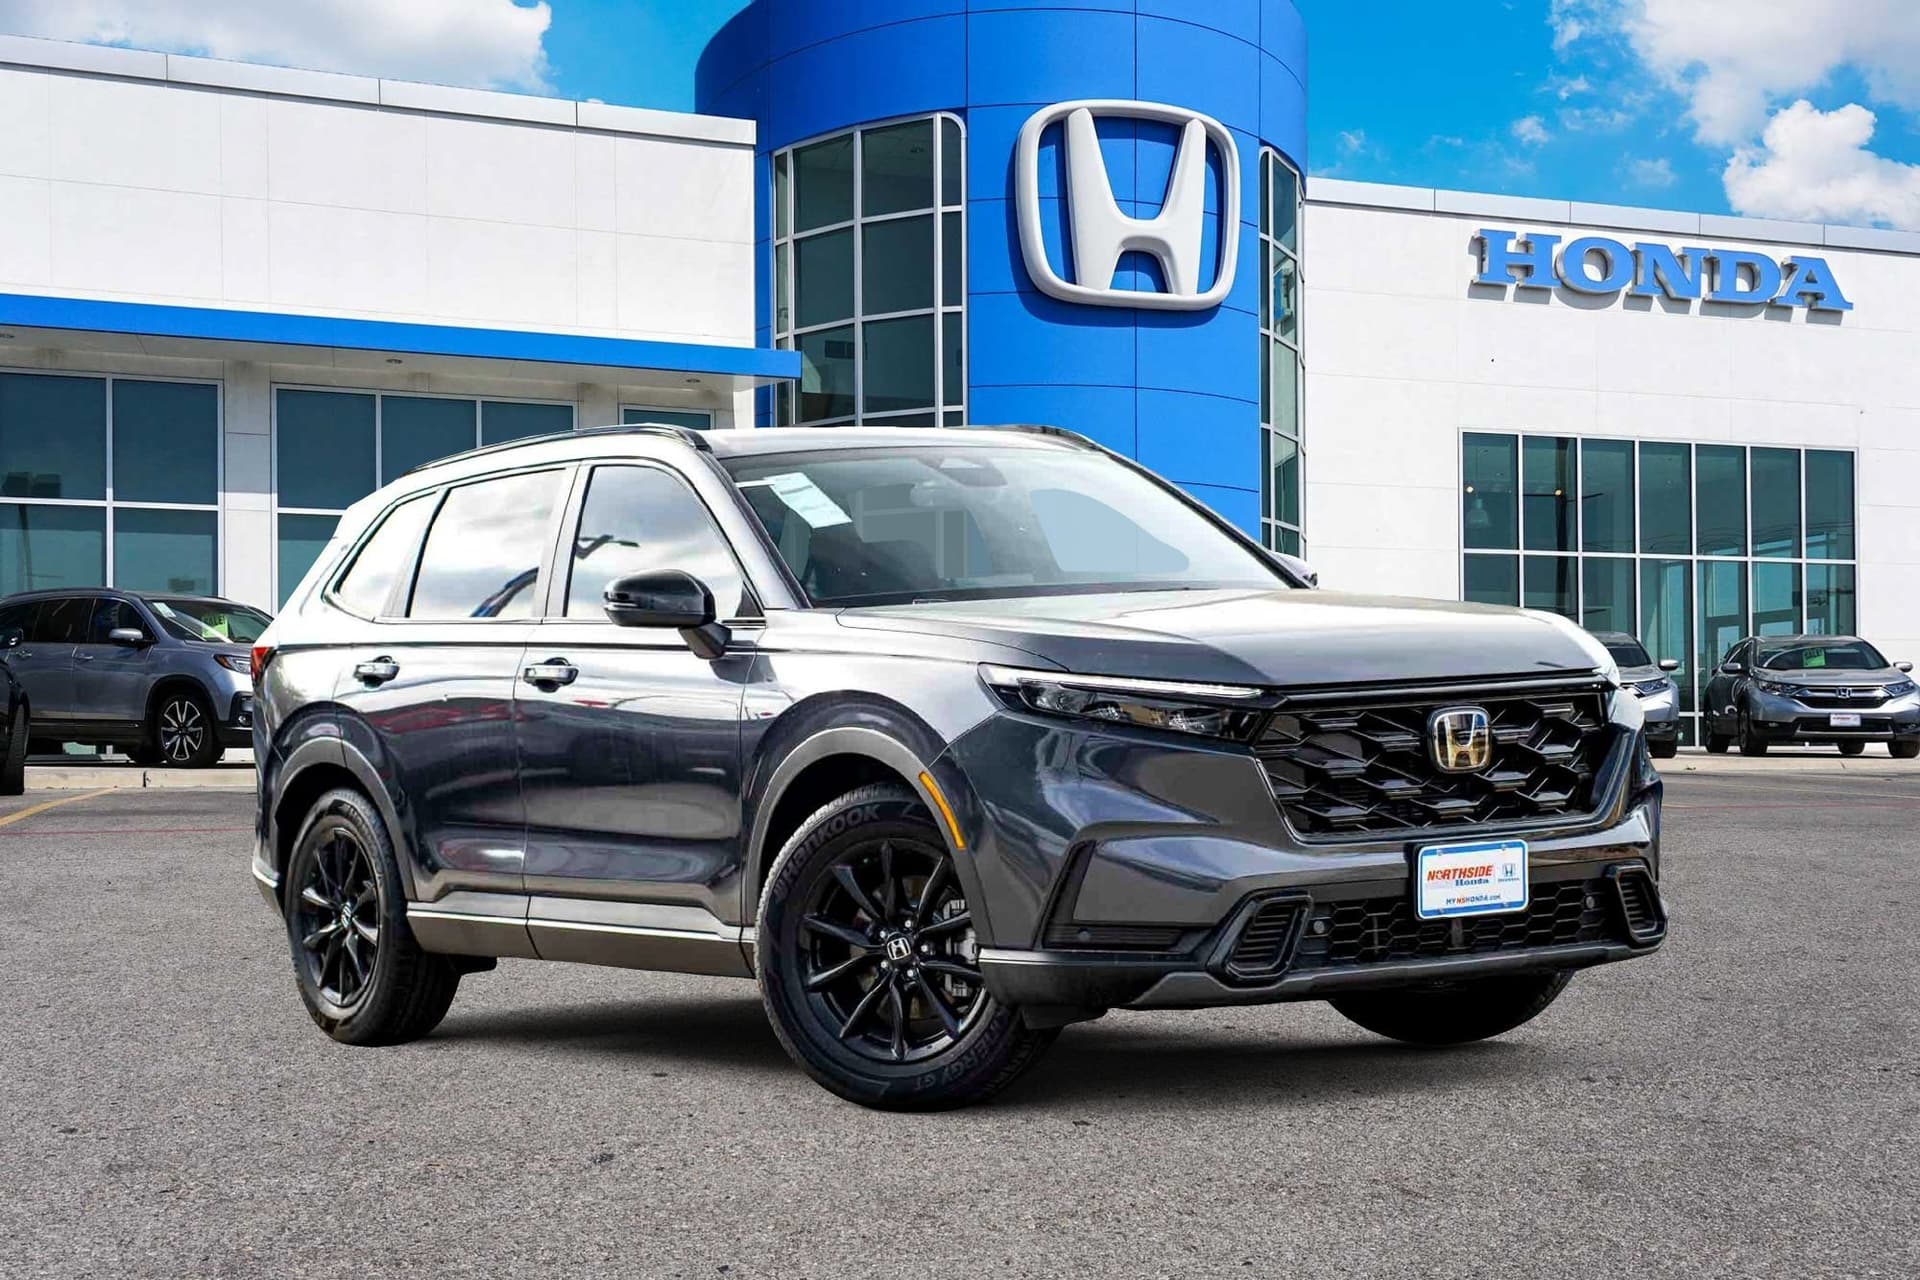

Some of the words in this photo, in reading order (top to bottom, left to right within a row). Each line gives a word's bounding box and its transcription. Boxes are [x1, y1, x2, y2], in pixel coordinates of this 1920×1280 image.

[1474, 228, 1854, 311] HONDA
[1427, 865, 1494, 881] NORTHSIDE
[1455, 878, 1490, 887] Honda
